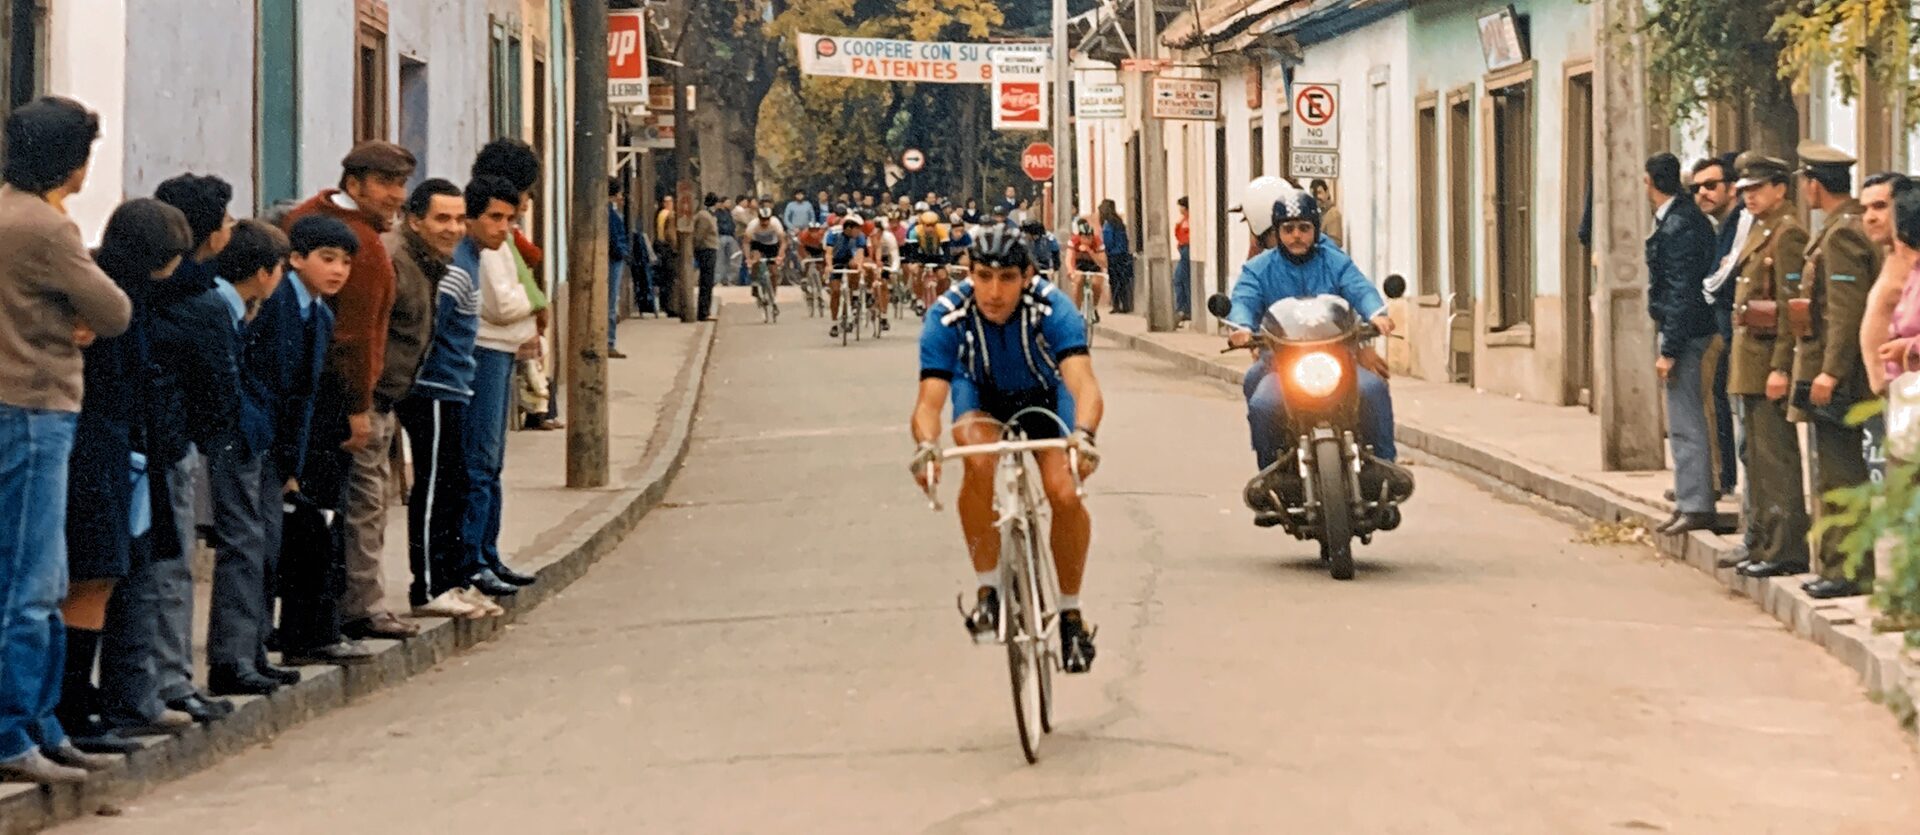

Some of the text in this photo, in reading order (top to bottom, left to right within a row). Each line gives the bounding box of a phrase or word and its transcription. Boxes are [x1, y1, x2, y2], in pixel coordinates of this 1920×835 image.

[843, 40, 912, 59] COOPERE
[920, 44, 951, 60] CON
[960, 45, 978, 61] SU
[852, 58, 957, 80] PATENTES
[1307, 128, 1323, 137] NO
[1025, 154, 1054, 168] PARE
[1295, 154, 1323, 164] BUSES
[1294, 165, 1336, 175] CAMIONES
